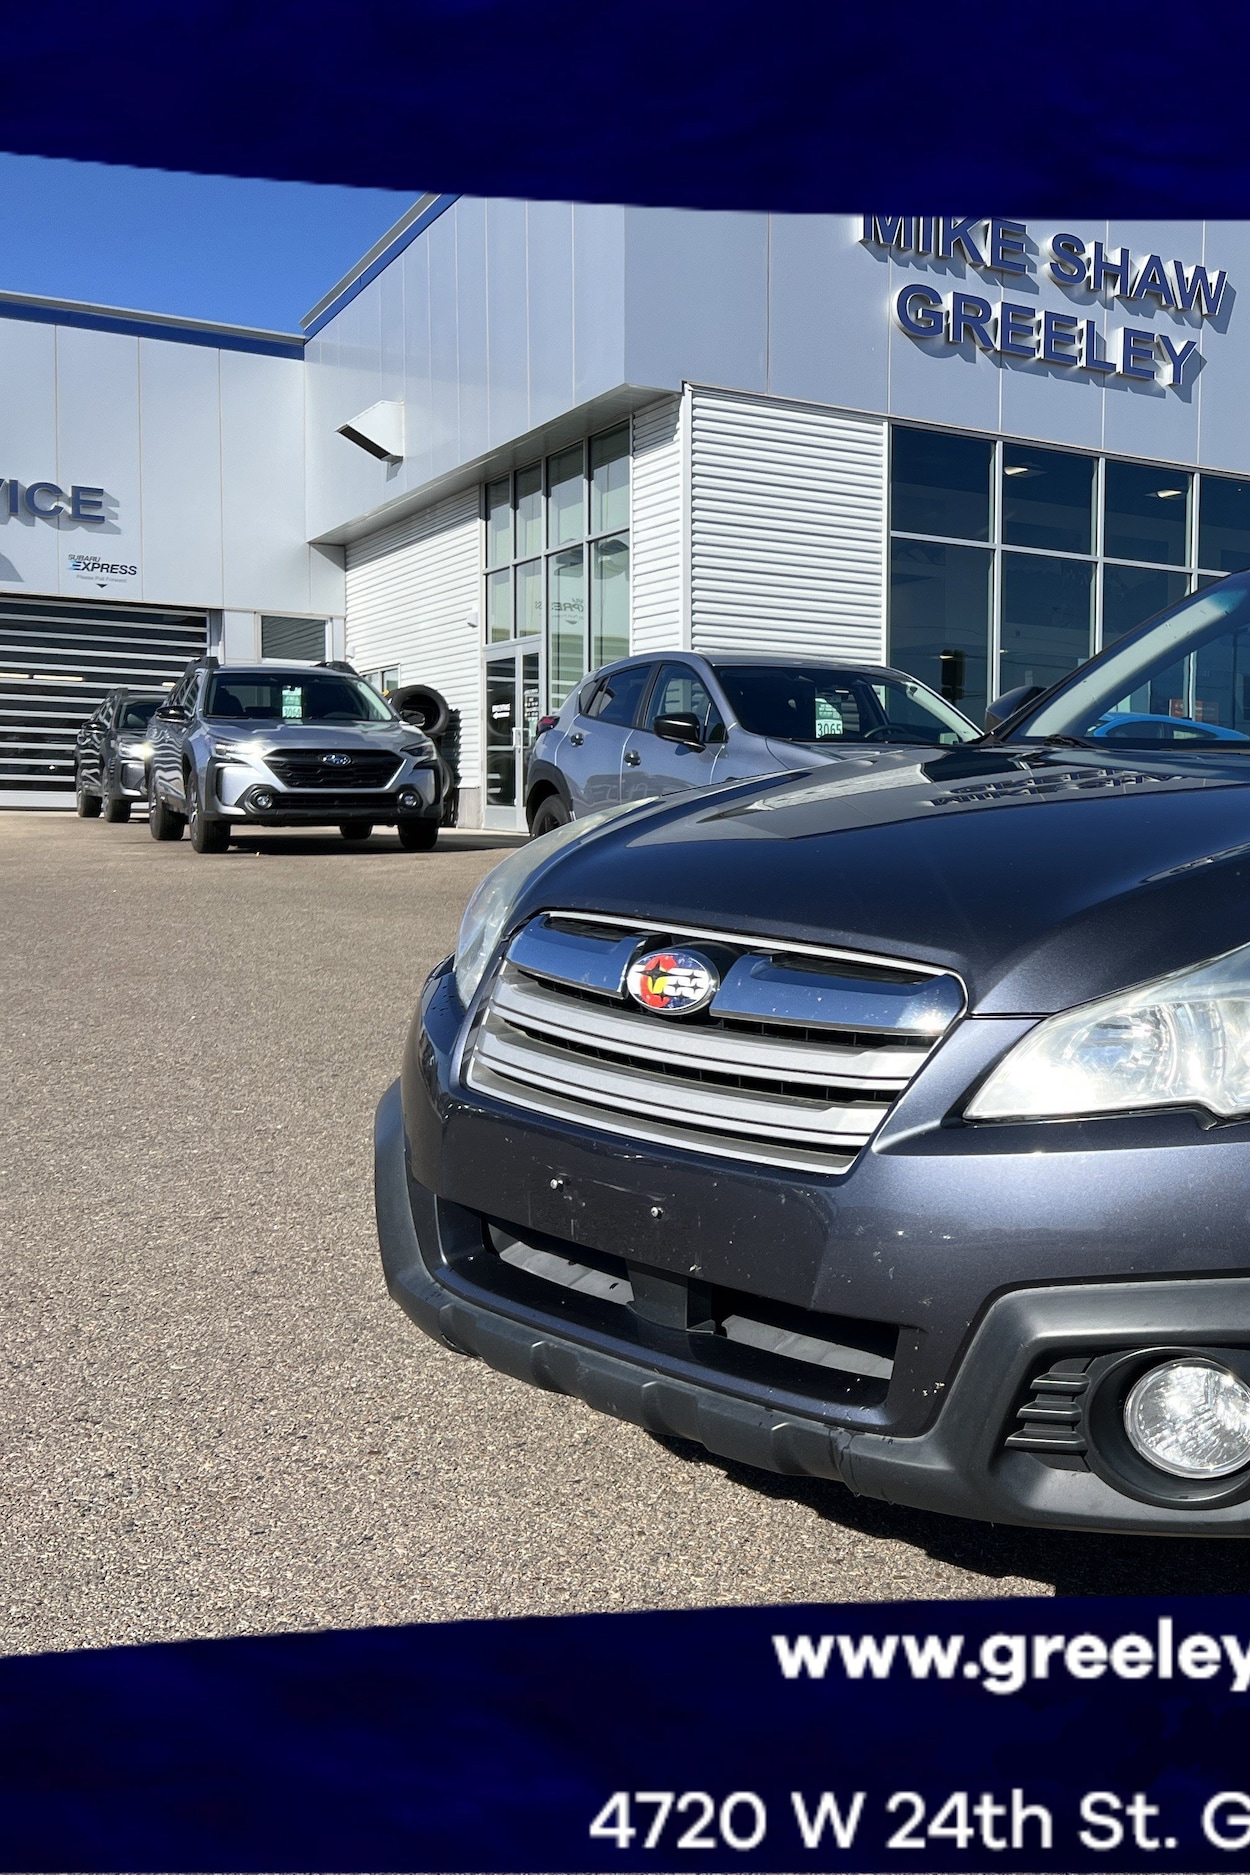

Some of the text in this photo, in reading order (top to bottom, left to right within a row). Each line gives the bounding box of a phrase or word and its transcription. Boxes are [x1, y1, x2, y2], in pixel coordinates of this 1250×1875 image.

[863, 215, 1227, 317] MIKE SHAW
[894, 283, 1197, 385] GREELEY
[0, 478, 106, 524] ICE
[68, 560, 138, 576] EXPRESS
[817, 723, 842, 737] 3065
